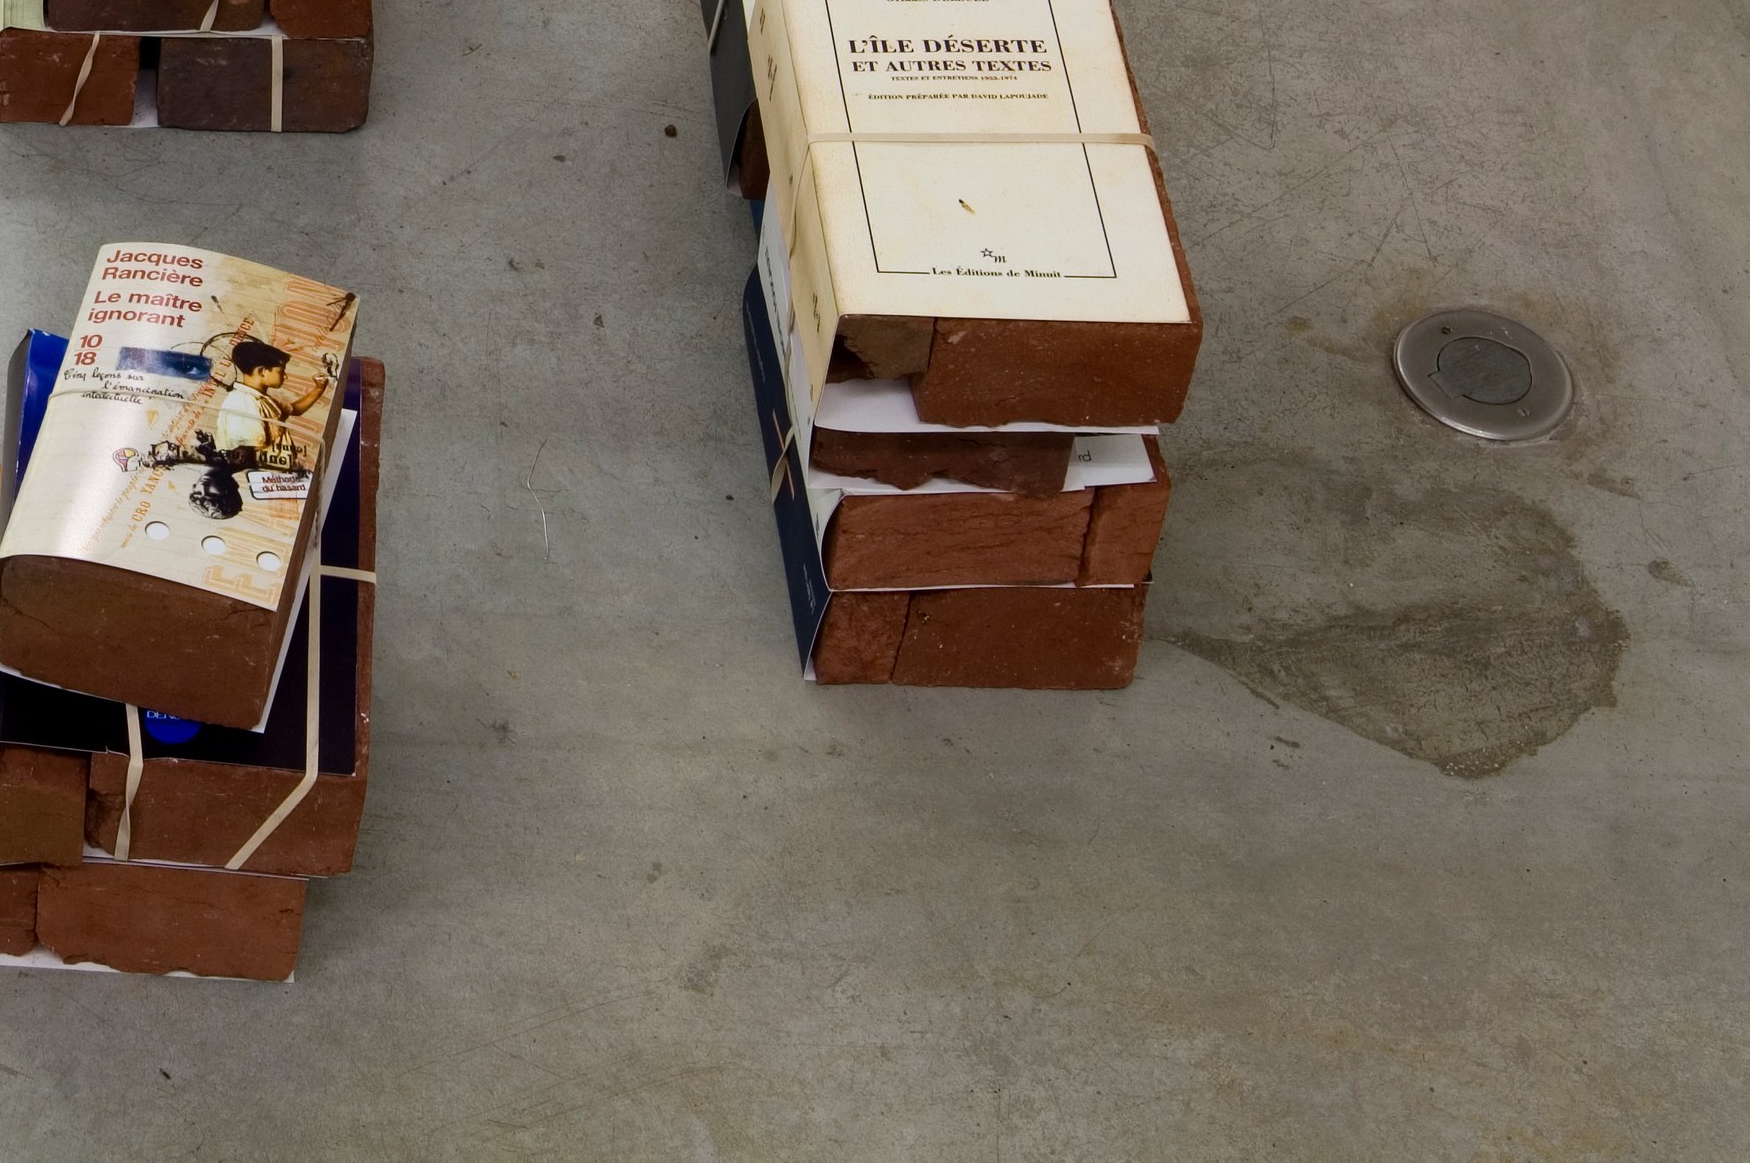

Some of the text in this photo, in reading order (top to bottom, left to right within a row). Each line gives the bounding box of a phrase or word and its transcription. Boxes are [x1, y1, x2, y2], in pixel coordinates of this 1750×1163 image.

[848, 35, 1048, 54] L'ÎLE DÉSERTE
[851, 60, 1052, 72] ET AUTRES TEXTES
[106, 250, 203, 270] Jacques
[102, 266, 203, 287] Rancière
[932, 266, 1062, 278] Les Éditions de Minuit
[94, 291, 203, 312] Le maître
[88, 307, 186, 328] ignorant
[79, 334, 103, 348] 10
[73, 351, 97, 366] 18
[92, 366, 122, 382] leçons
[126, 372, 144, 381] sur
